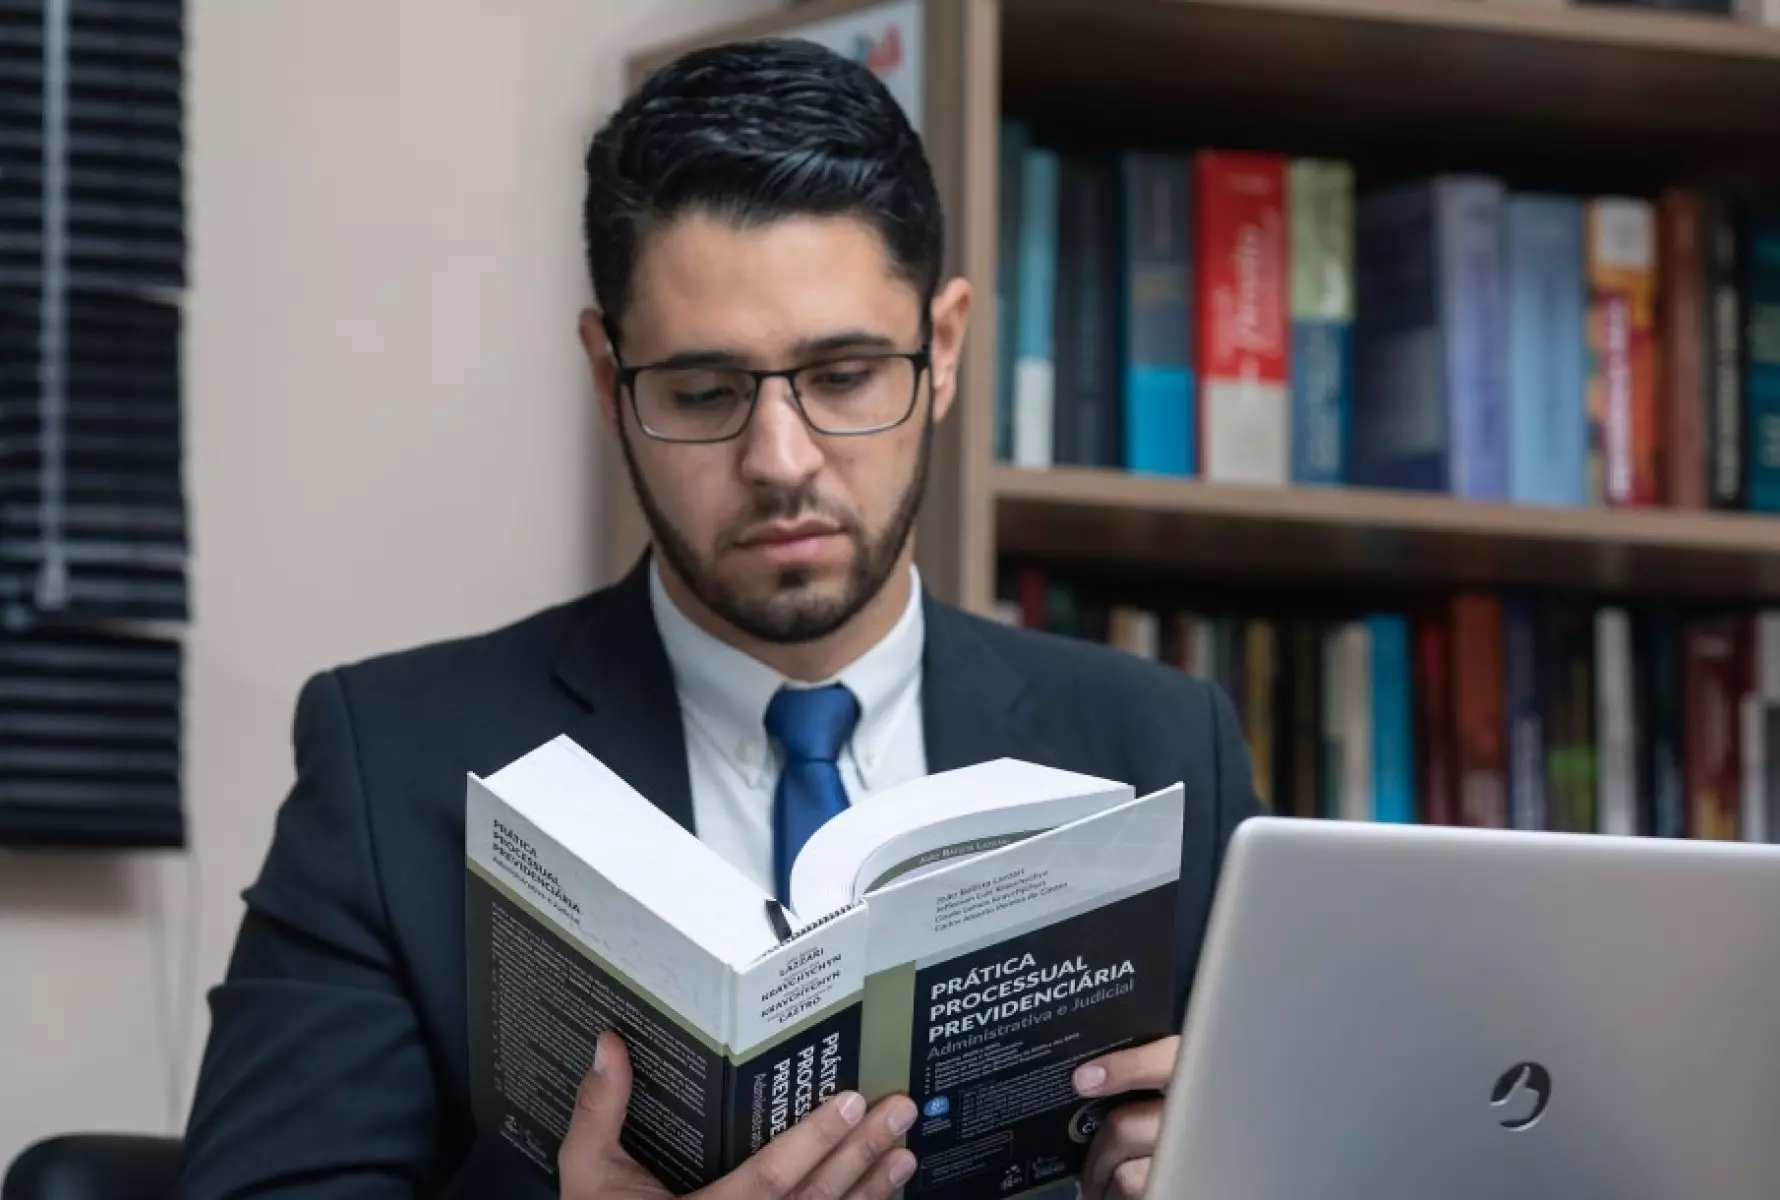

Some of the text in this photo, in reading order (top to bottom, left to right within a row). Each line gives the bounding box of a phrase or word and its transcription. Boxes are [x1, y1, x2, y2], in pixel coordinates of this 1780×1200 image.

[493, 818, 538, 858] PRÁTICA
[493, 831, 560, 889] PROCESSUAL
[493, 843, 580, 914] PREVIDENCIÁRIA
[928, 959, 1136, 1044] PREVIDENCIÁRIA
[930, 951, 1037, 1001] PRÁTICA
[930, 955, 1088, 1023] PROCESSUAL
[926, 978, 1135, 1062] Administrativa e Judicial
[794, 1044, 816, 1123] PROCES
[818, 1030, 842, 1102] PRÁTIC
